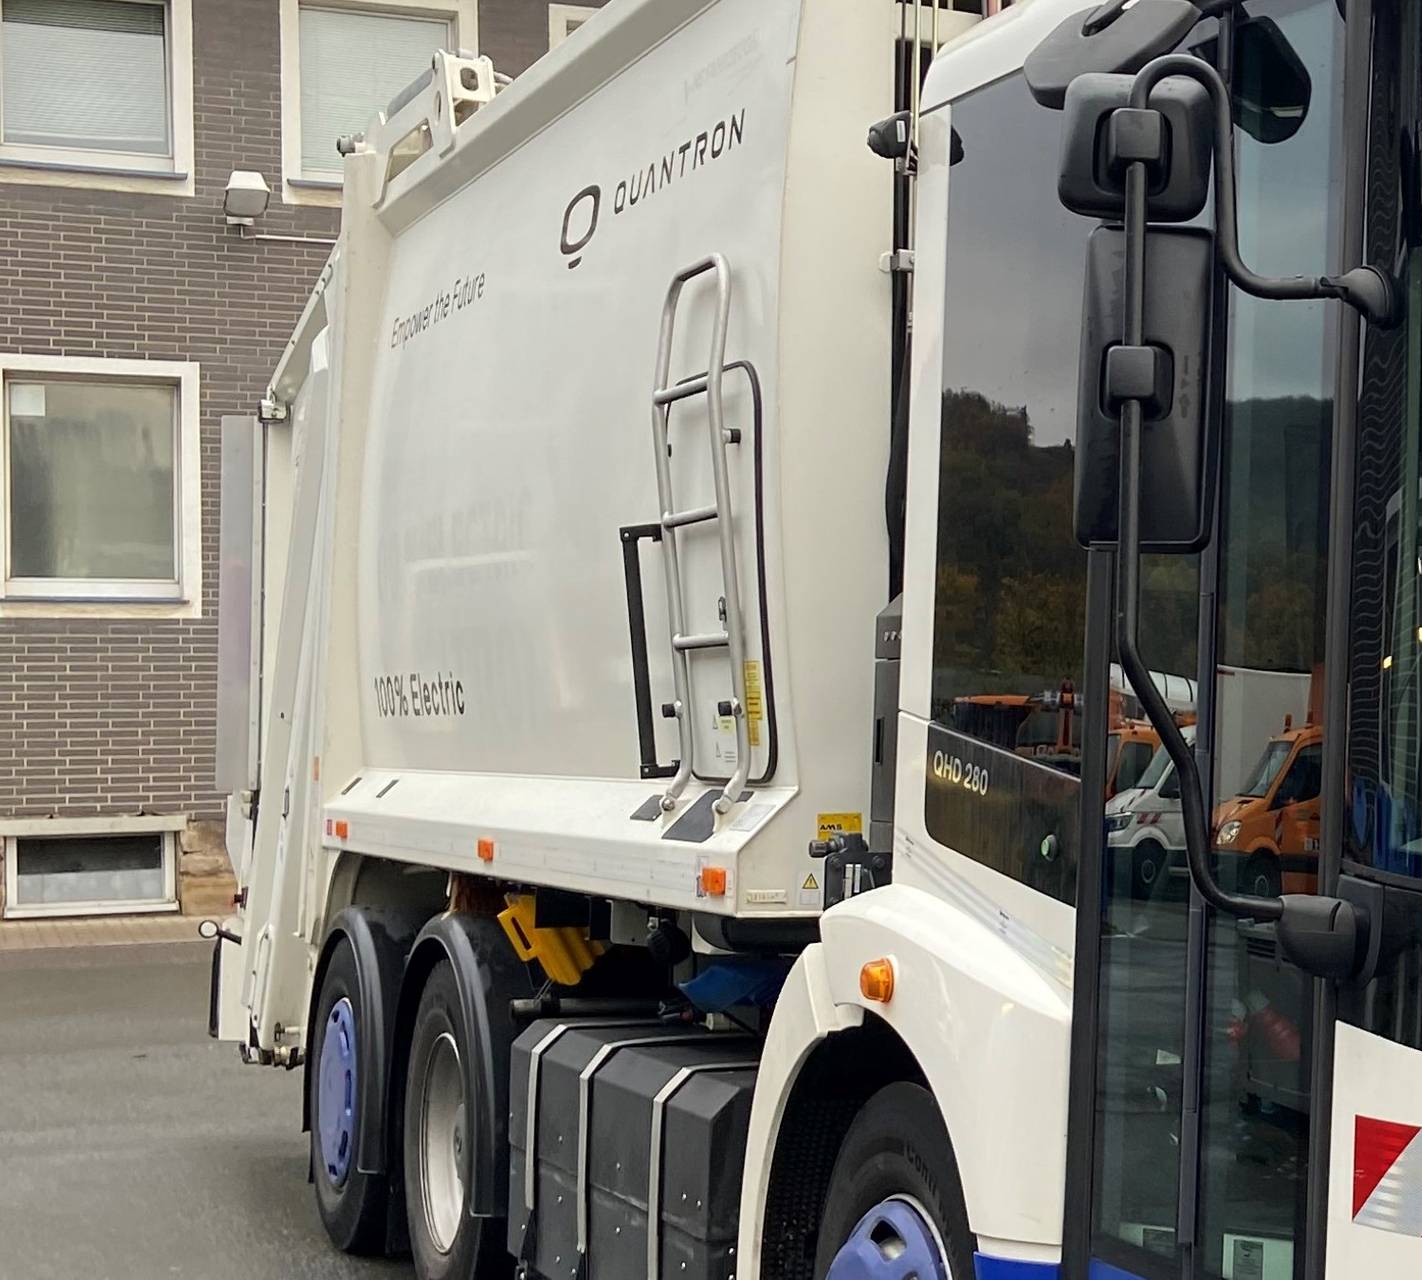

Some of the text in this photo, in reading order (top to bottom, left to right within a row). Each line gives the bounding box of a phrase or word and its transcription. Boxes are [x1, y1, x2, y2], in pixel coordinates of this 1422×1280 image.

[613, 107, 746, 215] QUANTRON
[391, 272, 485, 350] Empower the Future
[374, 670, 465, 717] 100% Electric
[933, 750, 989, 796] QHD 280
